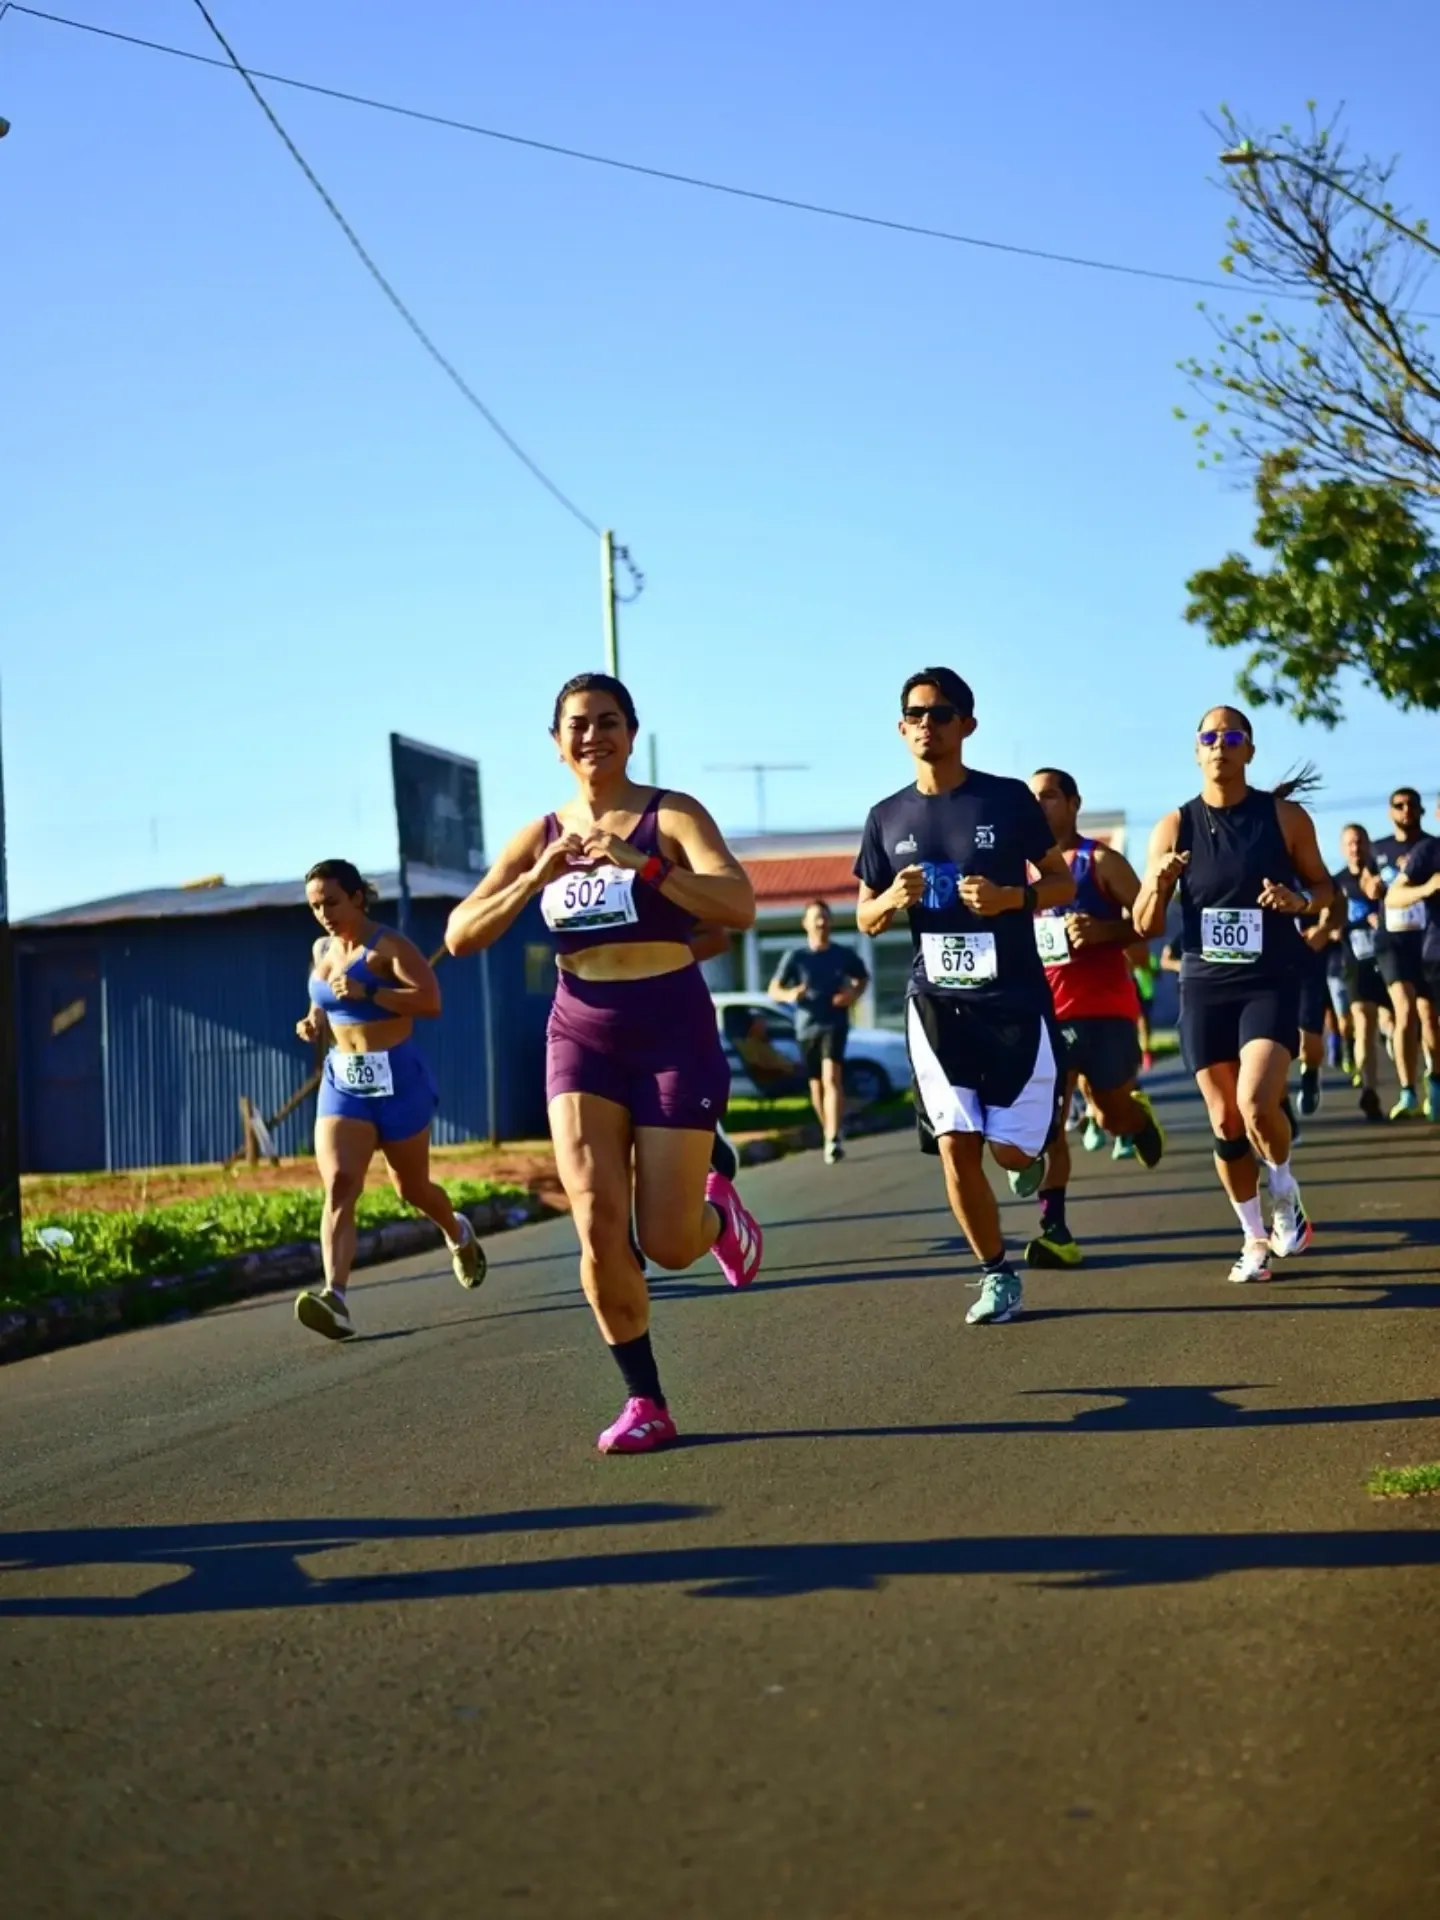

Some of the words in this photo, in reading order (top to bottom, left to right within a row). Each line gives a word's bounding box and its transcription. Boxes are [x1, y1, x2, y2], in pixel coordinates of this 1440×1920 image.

[564, 879, 606, 909] 502
[1212, 925, 1248, 946] 560
[941, 950, 975, 972] 673
[346, 1066, 375, 1085] 629
